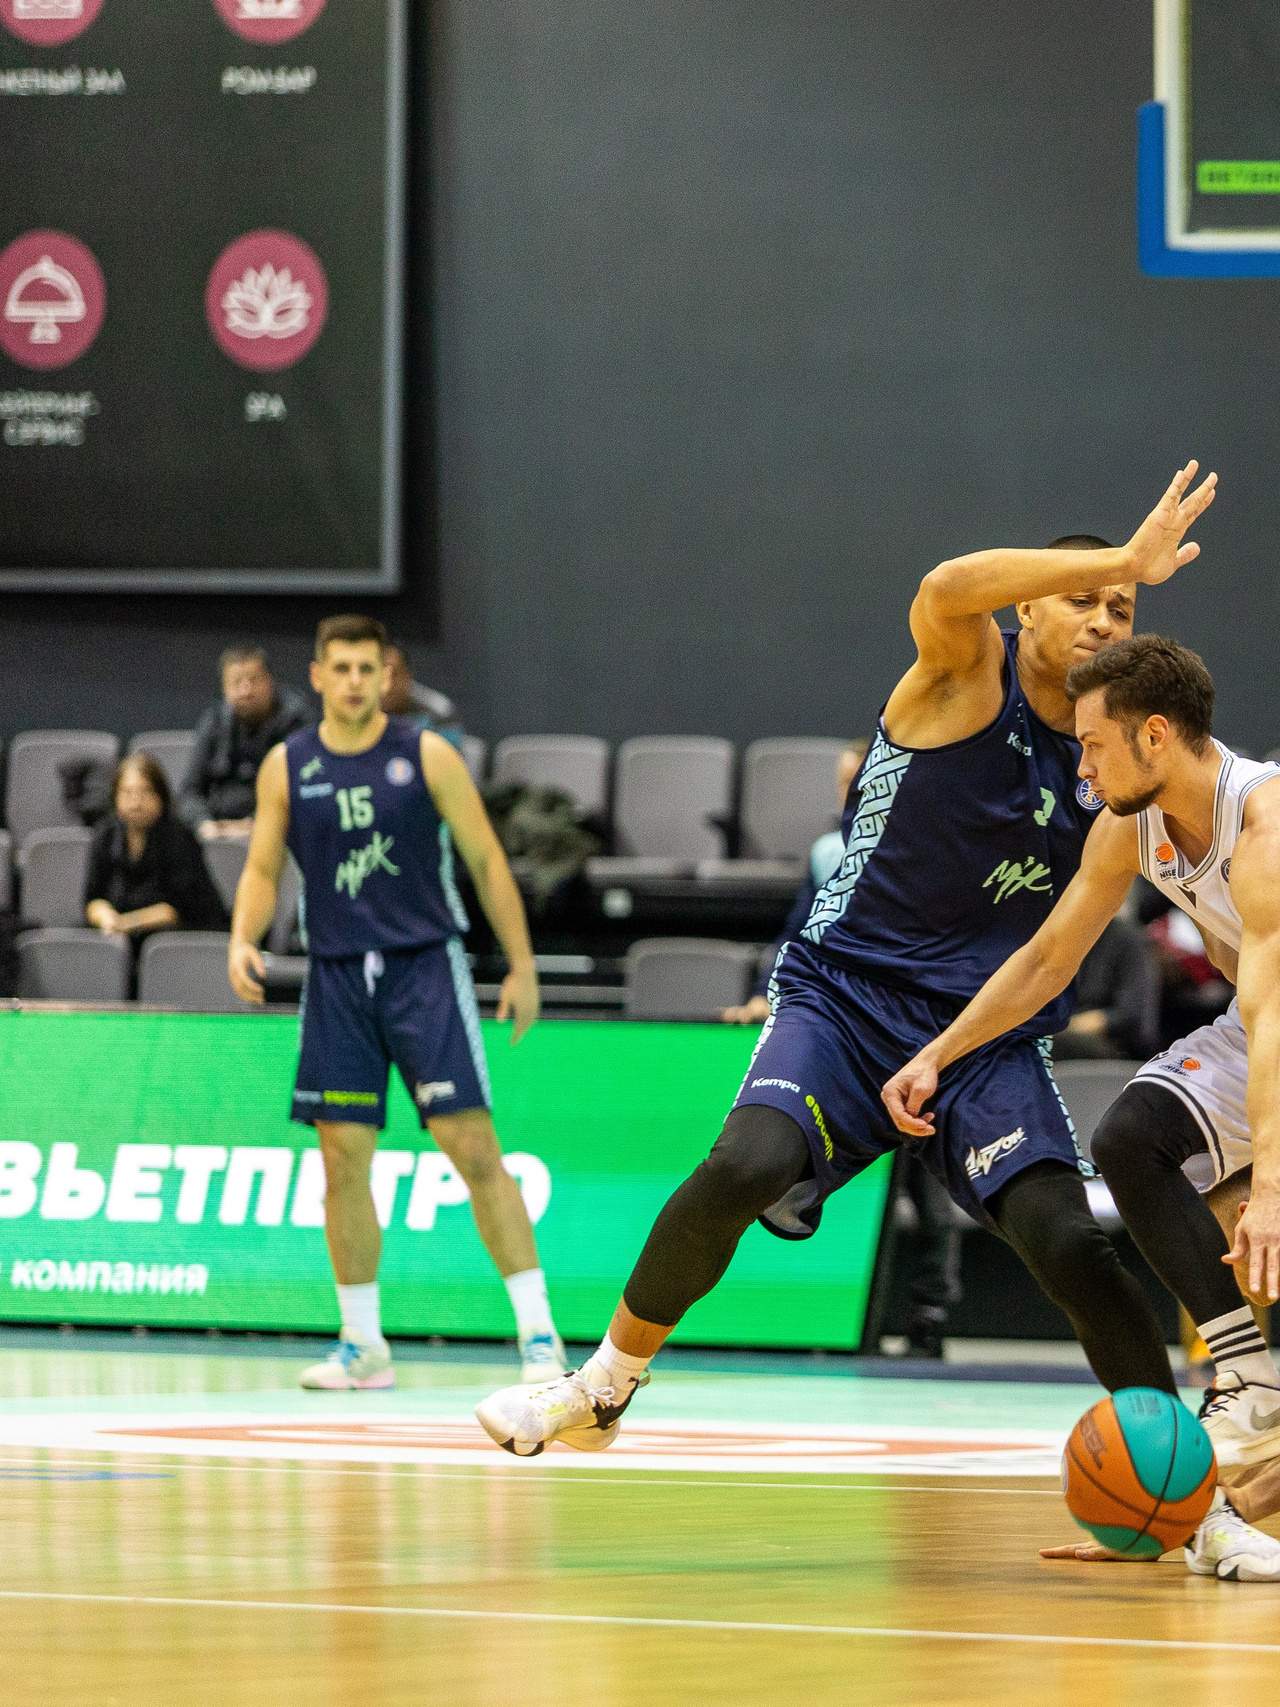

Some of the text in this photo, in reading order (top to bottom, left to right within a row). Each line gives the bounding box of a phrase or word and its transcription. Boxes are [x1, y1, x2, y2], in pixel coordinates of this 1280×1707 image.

[335, 784, 375, 832] 15
[751, 1078, 800, 1093] Kempa
[10, 1259, 208, 1296] компания
